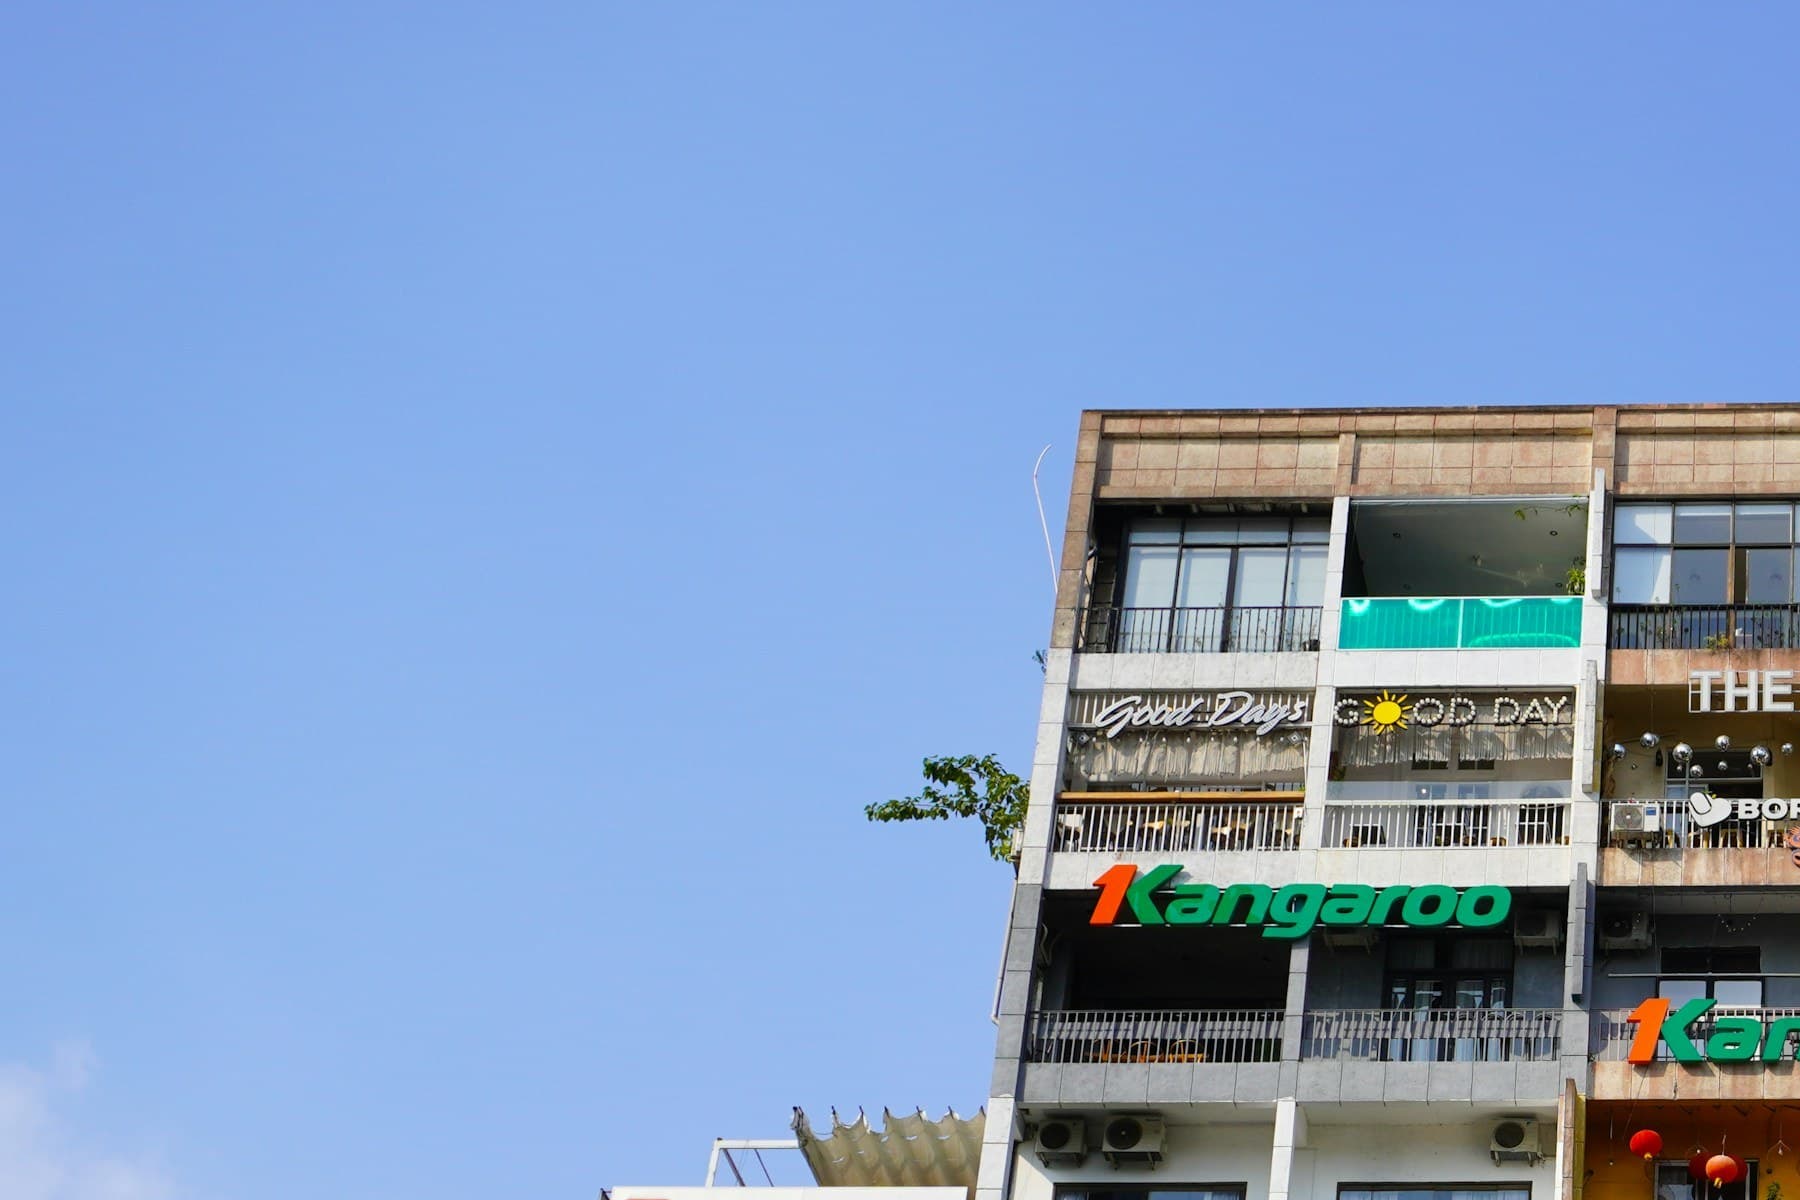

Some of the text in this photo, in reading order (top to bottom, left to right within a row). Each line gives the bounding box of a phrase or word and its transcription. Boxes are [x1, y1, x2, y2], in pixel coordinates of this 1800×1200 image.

[1493, 695, 1568, 725] DAY
[1689, 669, 1795, 712] THE
[1094, 690, 1307, 738] Good Days
